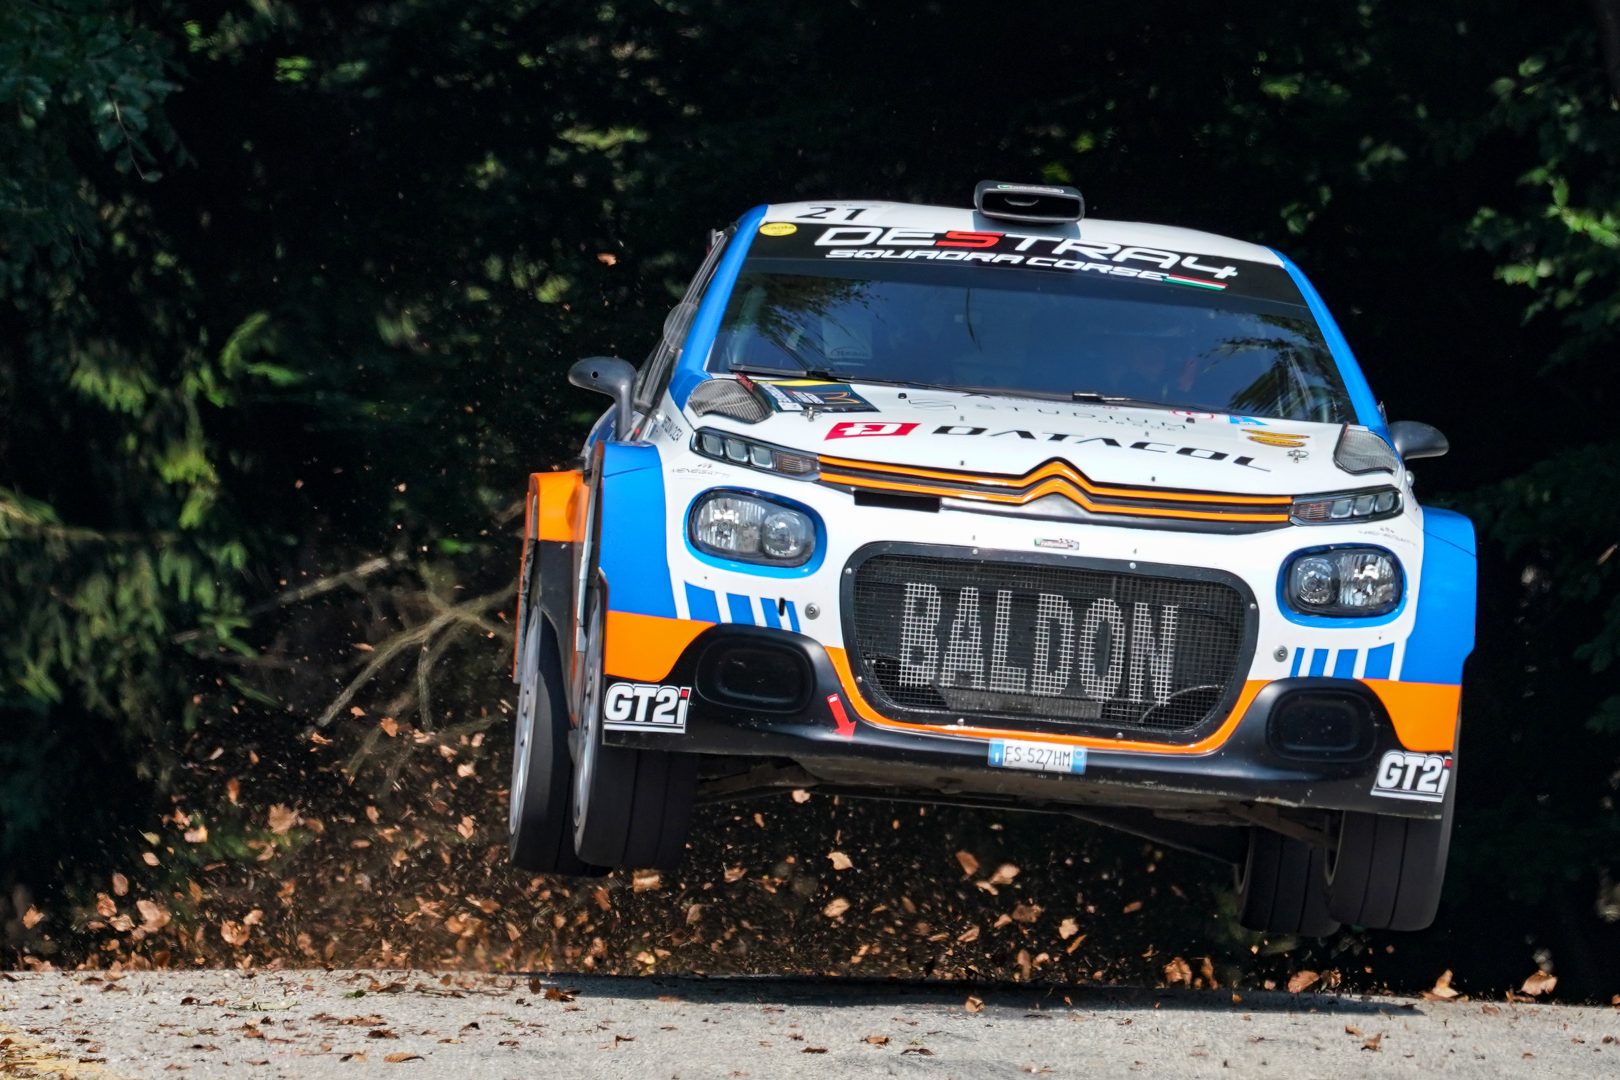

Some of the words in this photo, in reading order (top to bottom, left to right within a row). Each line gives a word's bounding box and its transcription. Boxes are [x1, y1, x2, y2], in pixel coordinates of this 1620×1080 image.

[795, 206, 867, 221] 21
[814, 227, 1239, 280] DESTRA4
[825, 249, 1019, 265] SQUADRA
[1025, 257, 1168, 281] CORSE
[932, 426, 1272, 472] DATACOL
[898, 582, 1179, 708] BALDON
[605, 682, 691, 727] GT2i
[1004, 745, 1022, 764] FS
[1027, 747, 1071, 769] 527HM
[1376, 751, 1452, 795] GT2i
